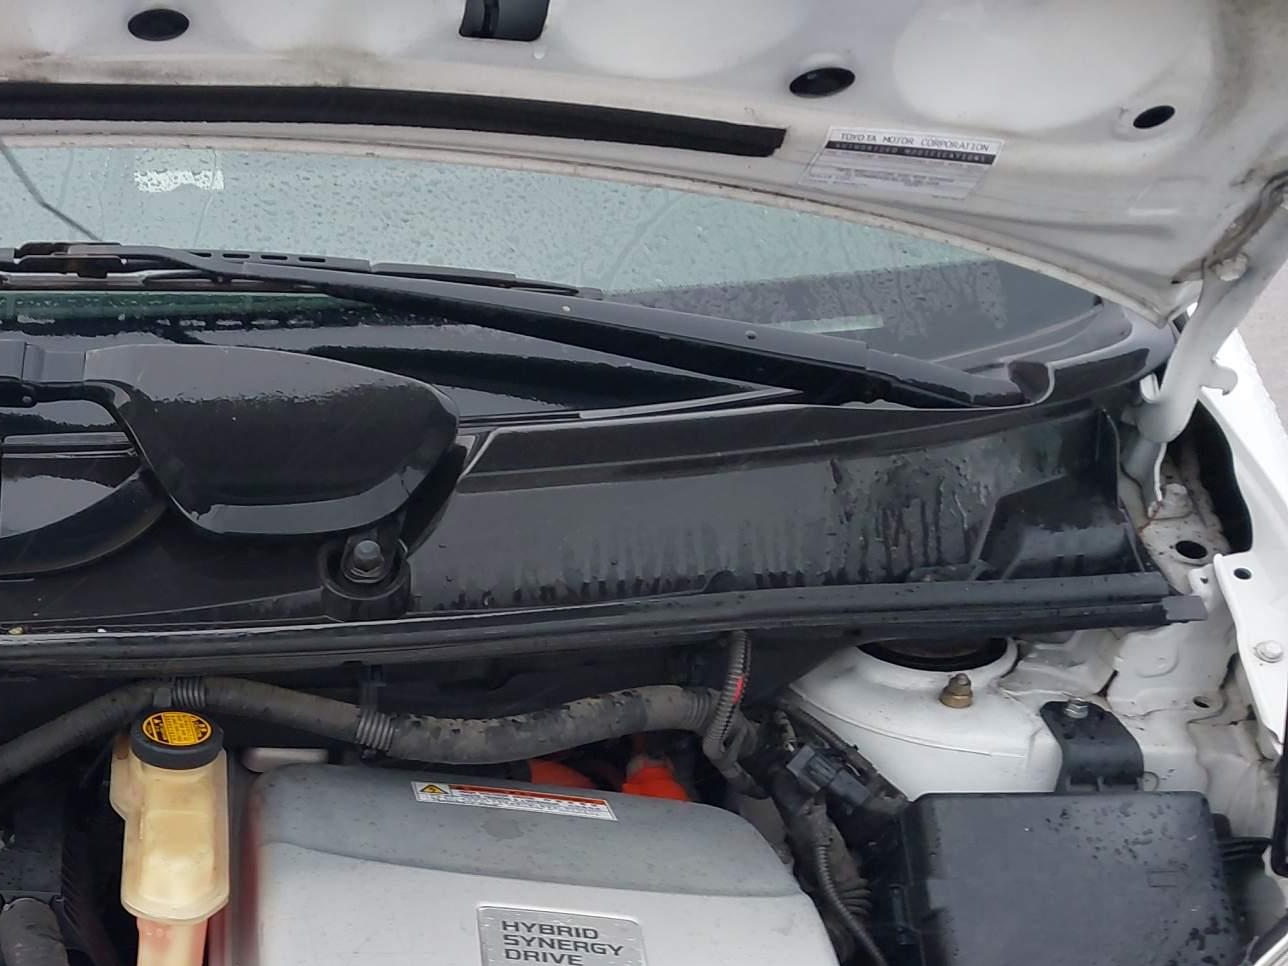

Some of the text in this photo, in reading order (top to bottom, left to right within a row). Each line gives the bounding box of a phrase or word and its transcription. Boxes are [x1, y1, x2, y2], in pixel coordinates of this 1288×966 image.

[920, 138, 990, 152] CORPORATION
[502, 920, 599, 940] HYBRID
[503, 934, 624, 956] SYNERGY
[504, 948, 583, 966] DRIVE
